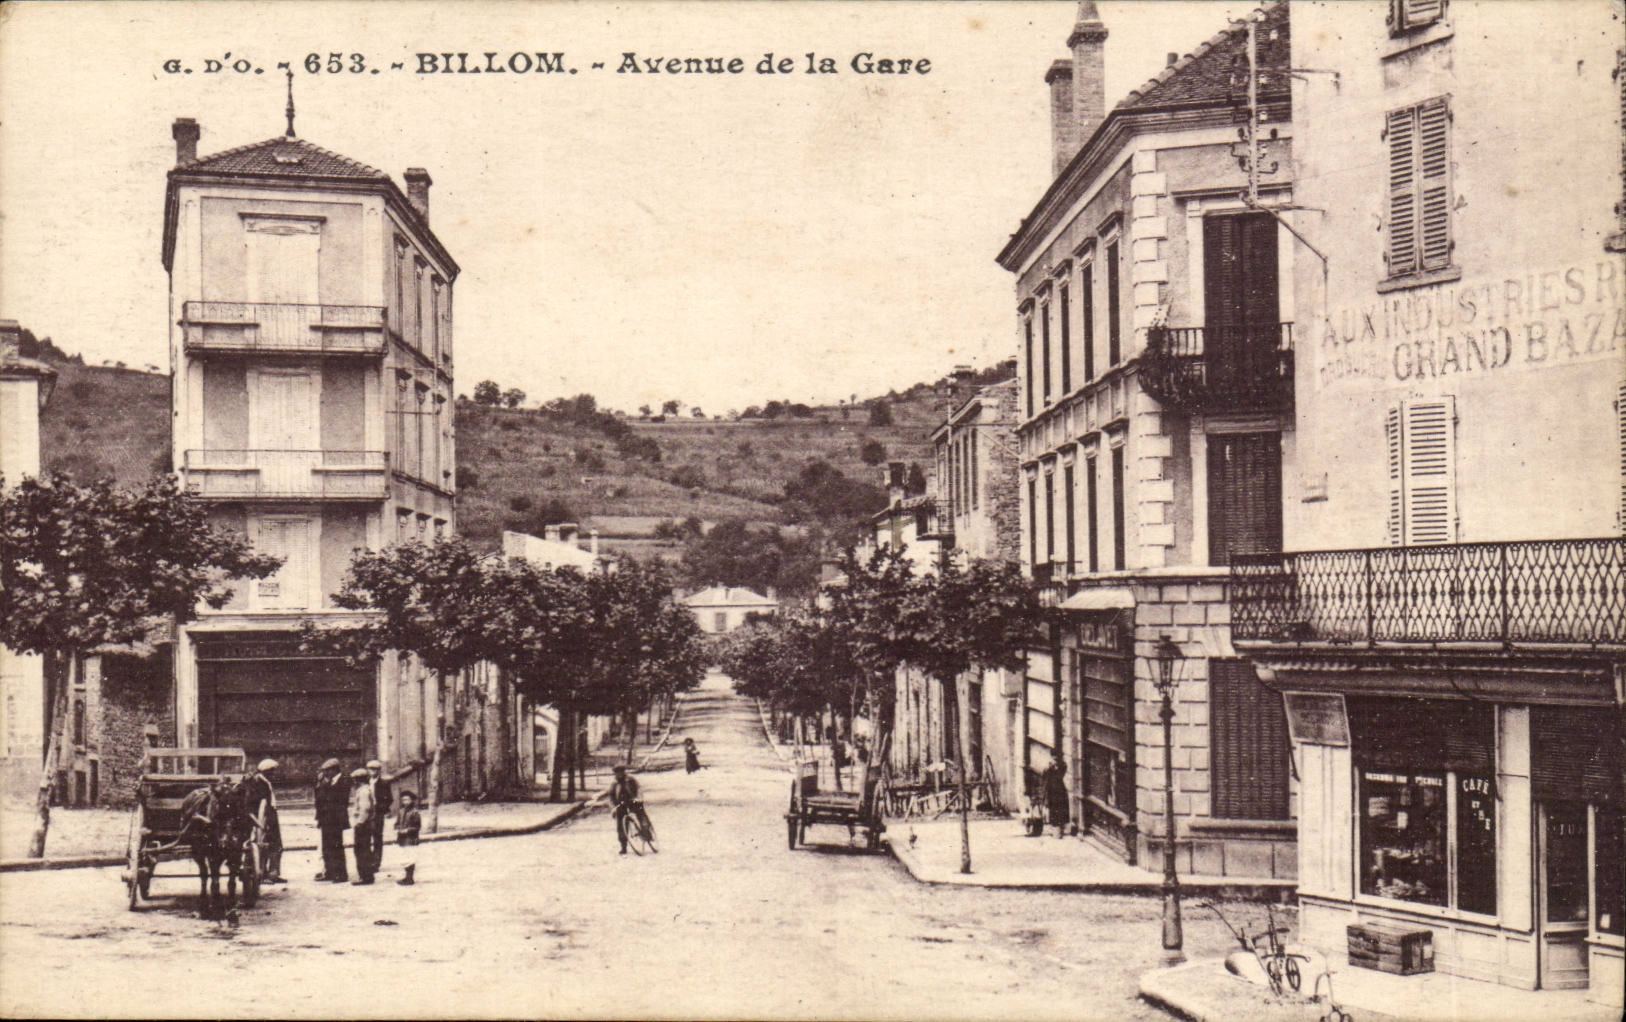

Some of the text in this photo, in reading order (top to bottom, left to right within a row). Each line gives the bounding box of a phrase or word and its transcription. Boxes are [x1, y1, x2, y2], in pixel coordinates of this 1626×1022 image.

[1320, 304, 1376, 347] AUX
[1383, 266, 1586, 339] INDUSTRIES
[1394, 326, 1512, 381] GRAND
[1462, 778, 1490, 796] CAFÉ
